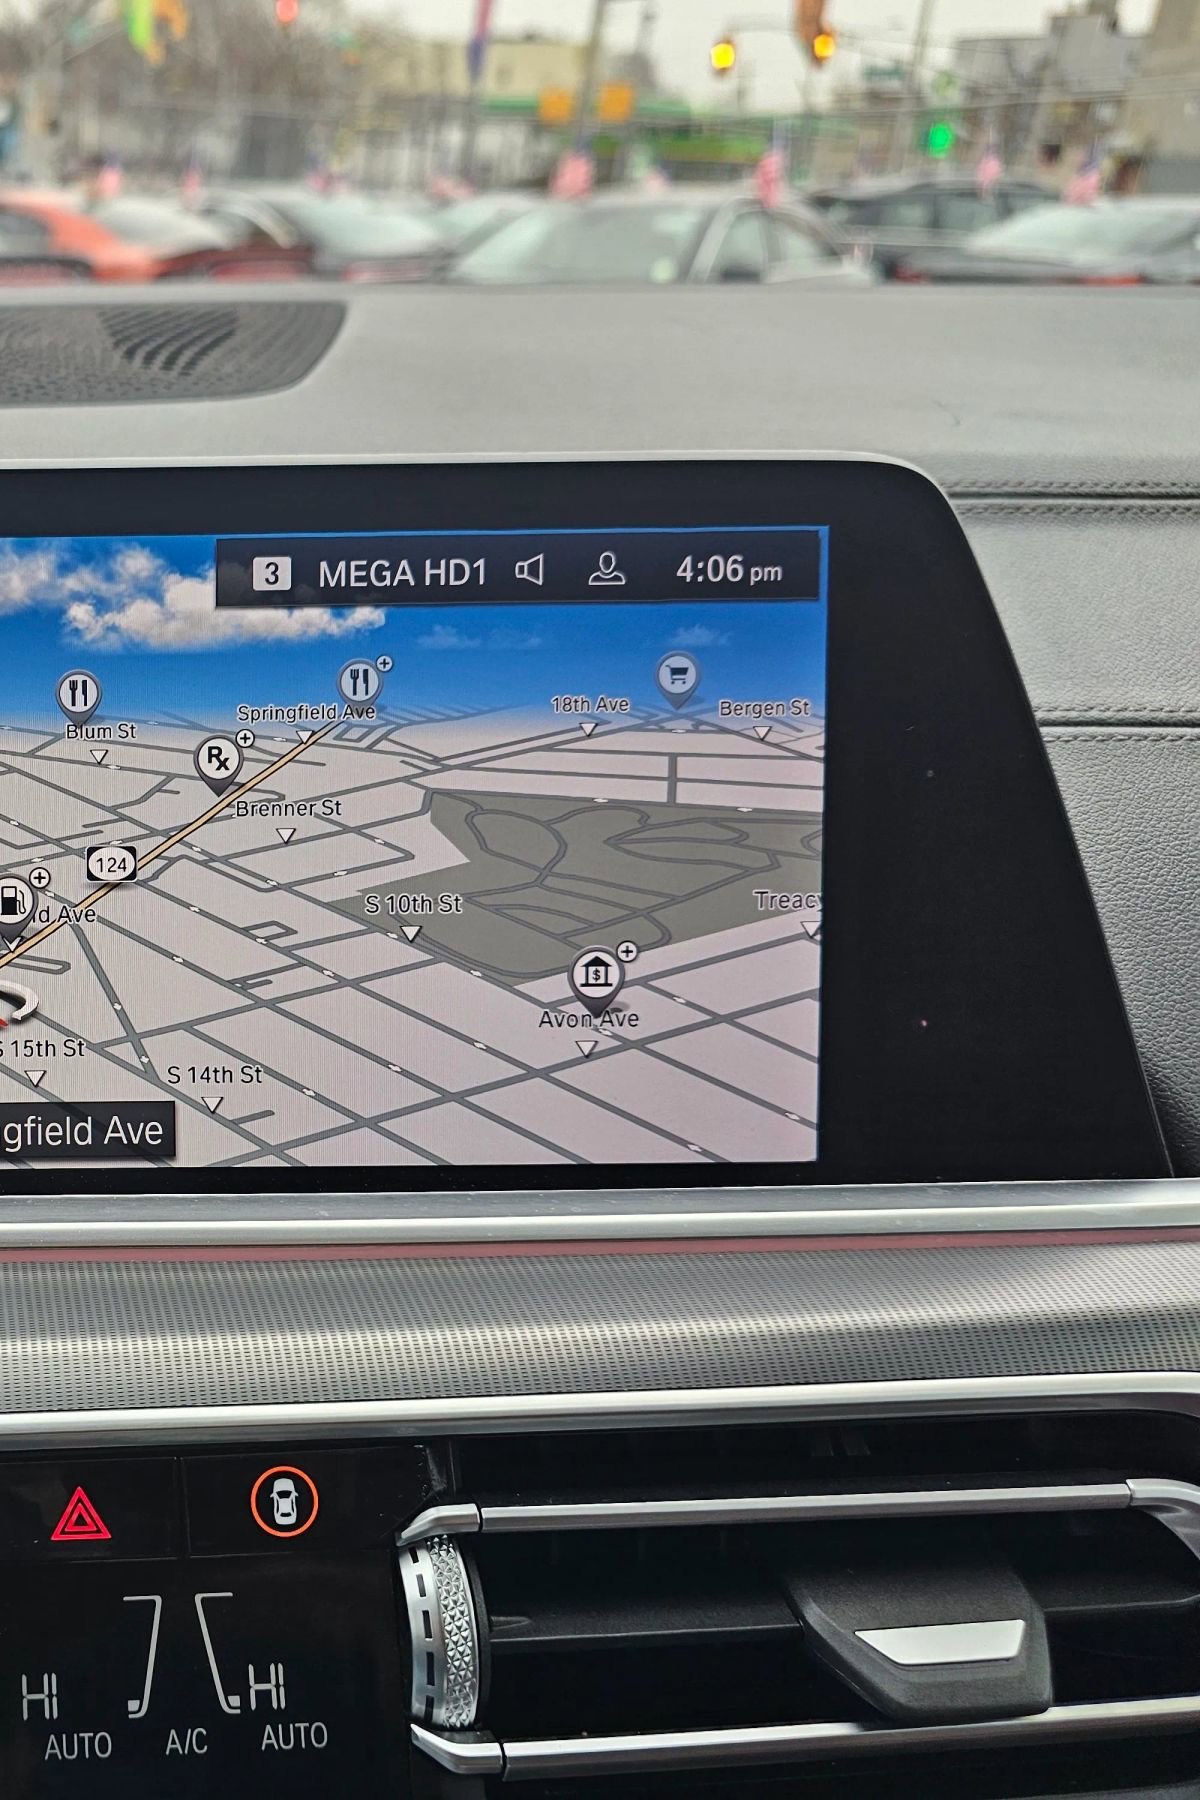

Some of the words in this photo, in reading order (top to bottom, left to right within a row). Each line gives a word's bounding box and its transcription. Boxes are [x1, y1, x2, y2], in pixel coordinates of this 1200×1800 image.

[264, 563, 280, 586] 3
[319, 559, 415, 587] MEGA
[426, 558, 486, 585] HD1
[676, 555, 744, 584] 4:06
[751, 563, 783, 586] pm
[238, 706, 336, 722] Springfield
[343, 705, 375, 718] Ave
[552, 696, 587, 712] 18th
[595, 696, 629, 712] Ave
[720, 700, 781, 719] Bergen
[789, 700, 810, 716] St
[66, 724, 107, 739] Blum
[117, 723, 136, 739] St
[236, 801, 315, 816] Brenner
[322, 800, 341, 815] St
[96, 857, 127, 873] 124
[365, 896, 378, 913] S
[386, 895, 432, 913] 10th
[440, 895, 462, 913] St
[754, 890, 821, 911] Treac
[57, 905, 96, 922] Ave
[539, 1011, 592, 1028] Avon
[599, 1011, 639, 1028] Ave
[11, 1040, 56, 1057] 15th
[64, 1040, 85, 1056] St
[168, 1067, 179, 1083] S
[188, 1067, 233, 1083] 14th
[240, 1066, 262, 1083] St
[104, 1116, 163, 1144] Ave
[249, 1663, 285, 1710] HI
[22, 1673, 58, 1720] HI
[45, 1732, 112, 1760] AUTO
[166, 1728, 207, 1755] A/C
[262, 1723, 328, 1751] AUTO
